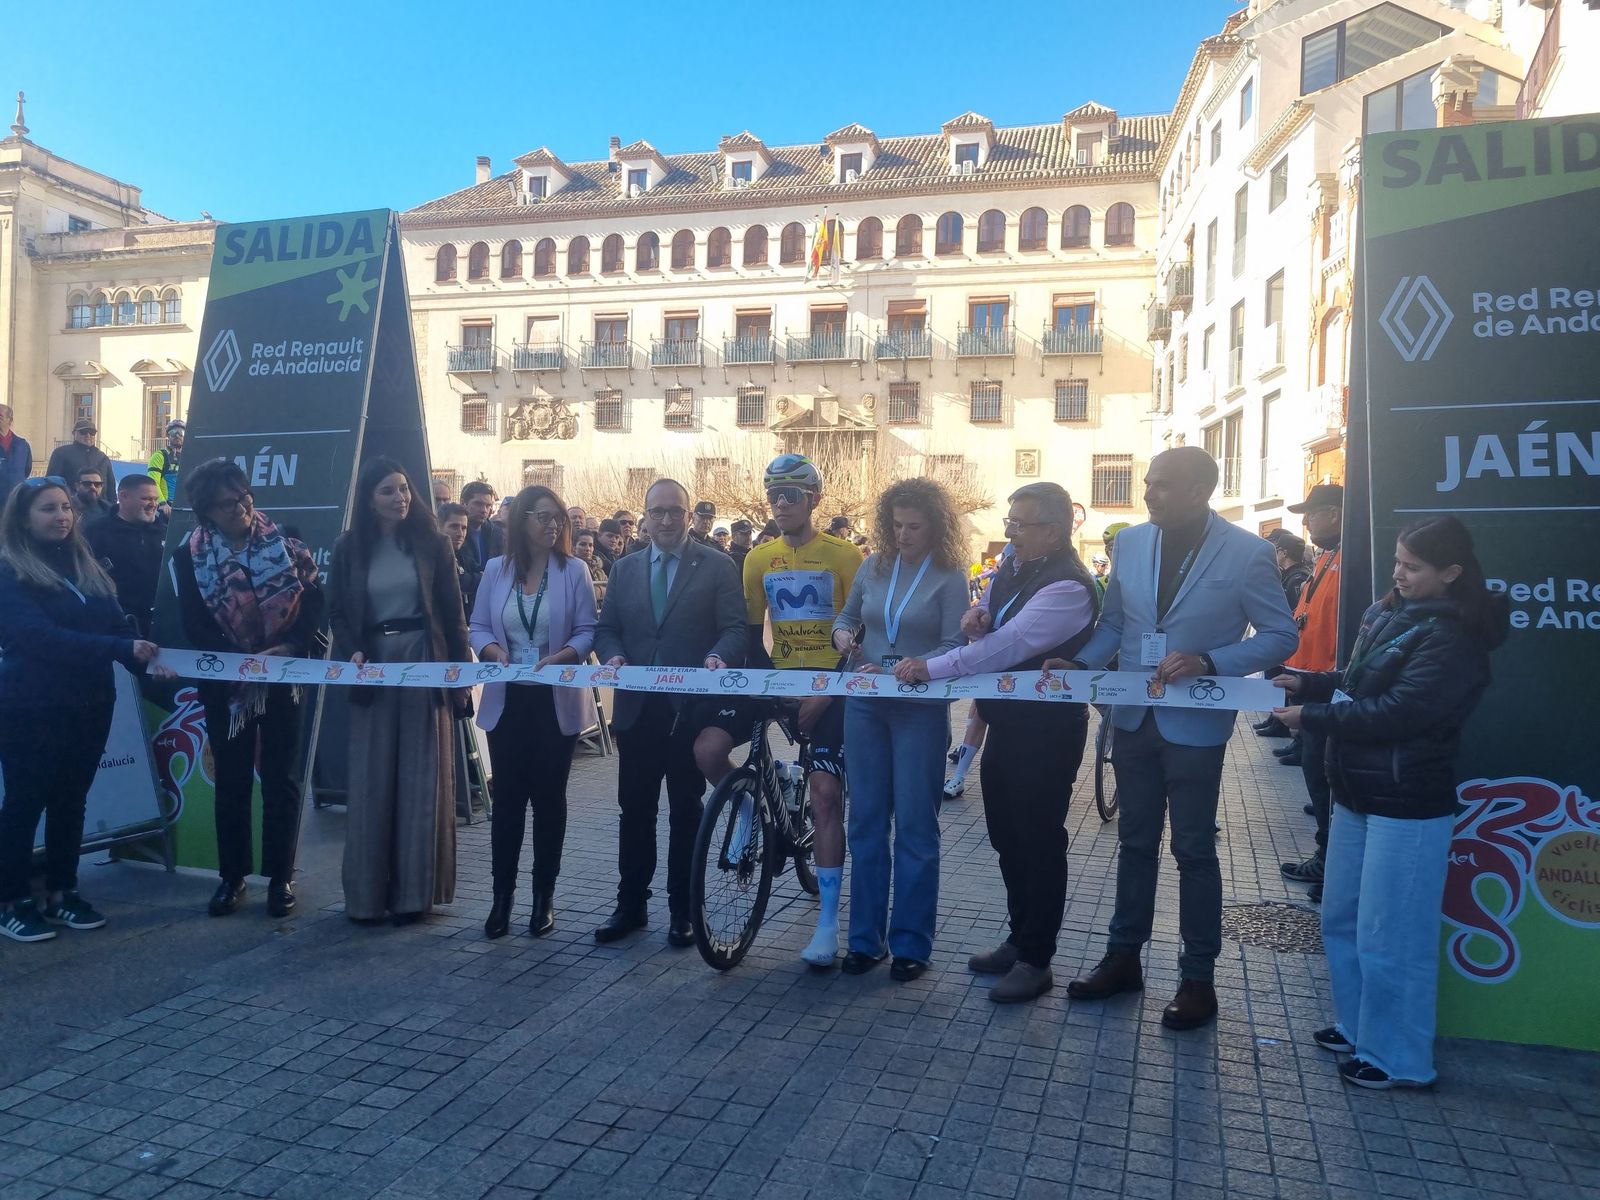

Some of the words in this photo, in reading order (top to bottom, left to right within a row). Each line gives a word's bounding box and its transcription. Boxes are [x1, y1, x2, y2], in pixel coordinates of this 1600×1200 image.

[222, 217, 375, 266] SALIDA
[1472, 287, 1539, 313] Red
[1550, 286, 1600, 309] Re
[1472, 314, 1515, 338] de
[252, 341, 287, 358] Red
[291, 337, 364, 356] Renault
[249, 359, 269, 376] de
[271, 352, 361, 375] Andalucía
[218, 446, 298, 487] ÉN
[1435, 420, 1600, 492] JAÉN
[795, 644, 826, 652] RENAULT
[655, 672, 685, 685] JAÉN
